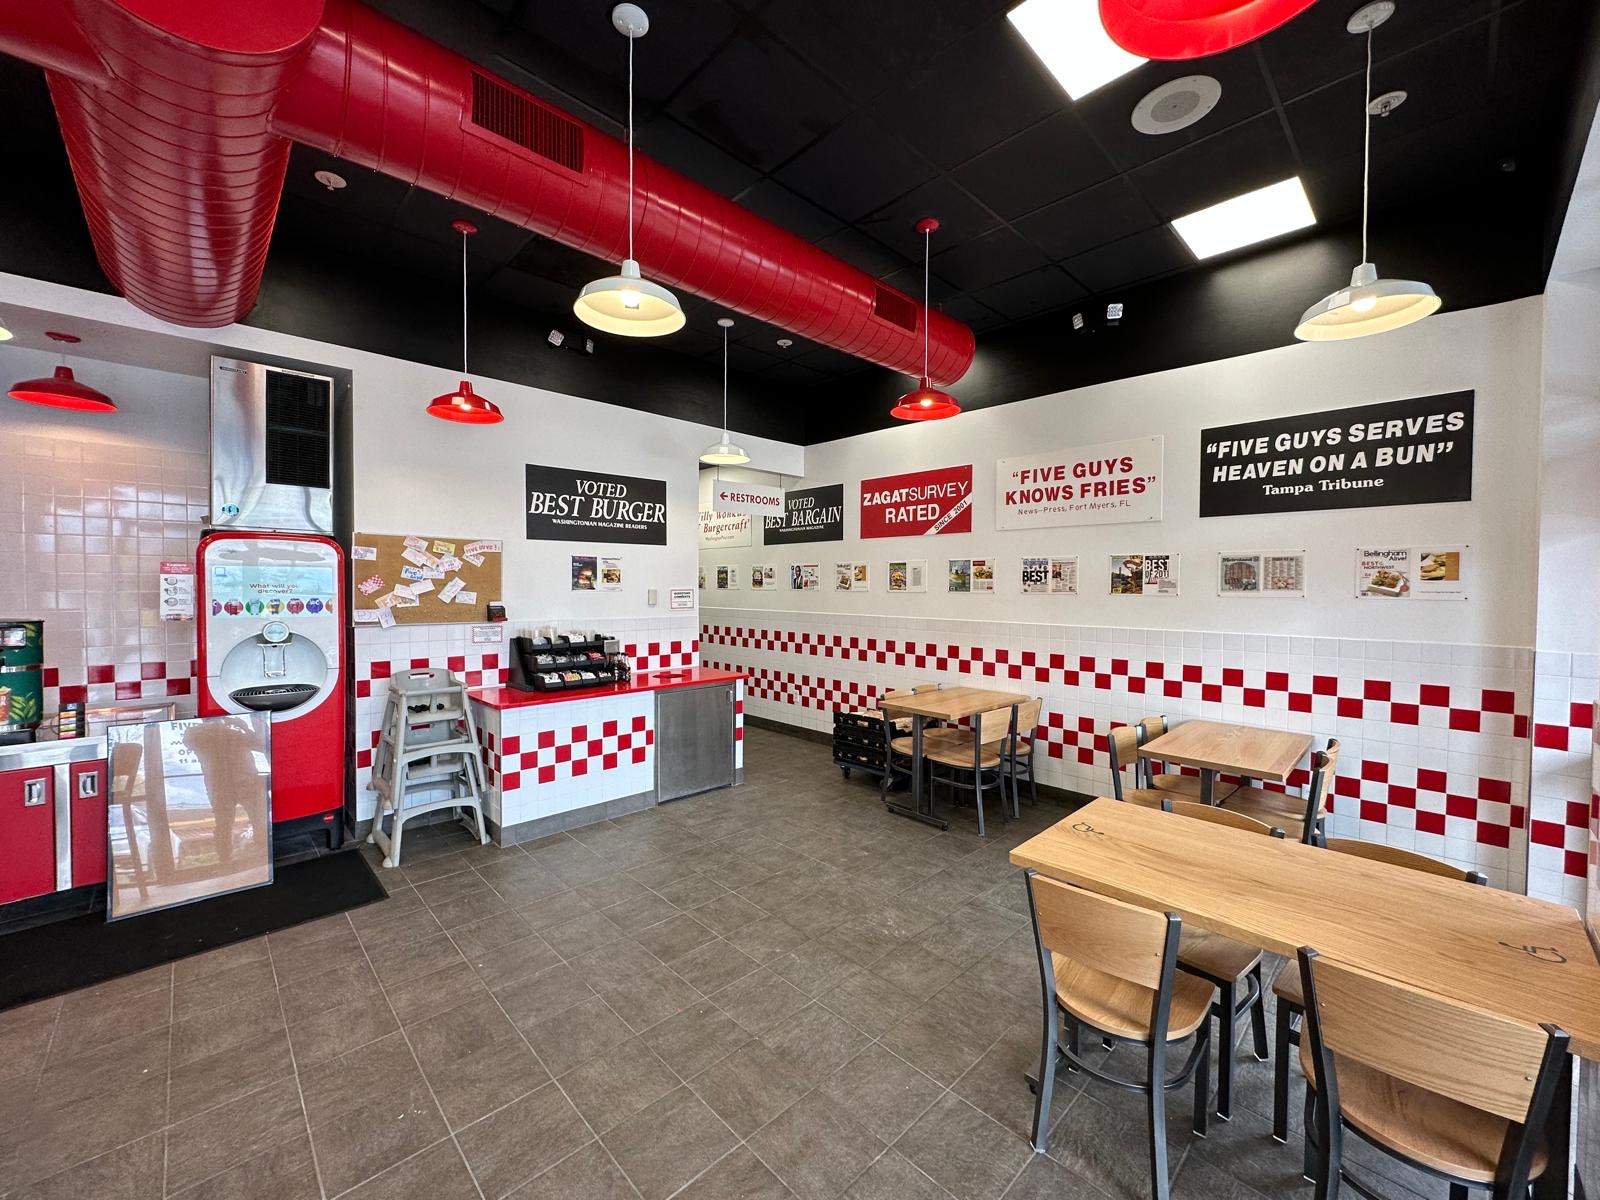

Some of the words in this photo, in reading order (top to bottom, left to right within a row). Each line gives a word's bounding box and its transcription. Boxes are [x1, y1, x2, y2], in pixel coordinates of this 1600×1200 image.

[1206, 437, 1270, 459] “FIVE
[1274, 427, 1342, 453] GUYS
[1348, 411, 1465, 443] SERVES
[1012, 465, 1066, 485] “FIVE
[1072, 456, 1134, 480] GUYS
[1212, 458, 1303, 483] HEAVEN
[1309, 453, 1345, 474] ON
[1350, 451, 1368, 470] A
[1374, 441, 1454, 467] BUN”
[575, 479, 627, 499] VOTED
[863, 480, 969, 507] ZAGATSURVEY
[1005, 485, 1074, 506] KNOWS
[1079, 475, 1156, 499] FRIES”
[1262, 483, 1314, 496] Tampa
[1318, 477, 1384, 492] Tribune
[528, 491, 586, 517] BEST
[590, 497, 666, 524] BURGER
[730, 492, 781, 507] RESTROOMS
[787, 496, 815, 511] VOTED
[1069, 503, 1087, 512] Fort
[1089, 501, 1118, 511] Myers,
[552, 518, 598, 528] WASHINGTONIAN
[598, 521, 625, 529] MAGAZINE
[765, 512, 788, 529] BEST
[791, 505, 842, 527] BARGAIN
[885, 503, 940, 524] RATED
[934, 513, 952, 532] SINCE
[952, 499, 968, 515] 2001
[1363, 550, 1407, 558] Bellingham
[1145, 559, 1169, 571] BEST
[1145, 570, 1153, 578] OF
[1154, 570, 1170, 579] 2011
[1022, 570, 1050, 582] BEST
